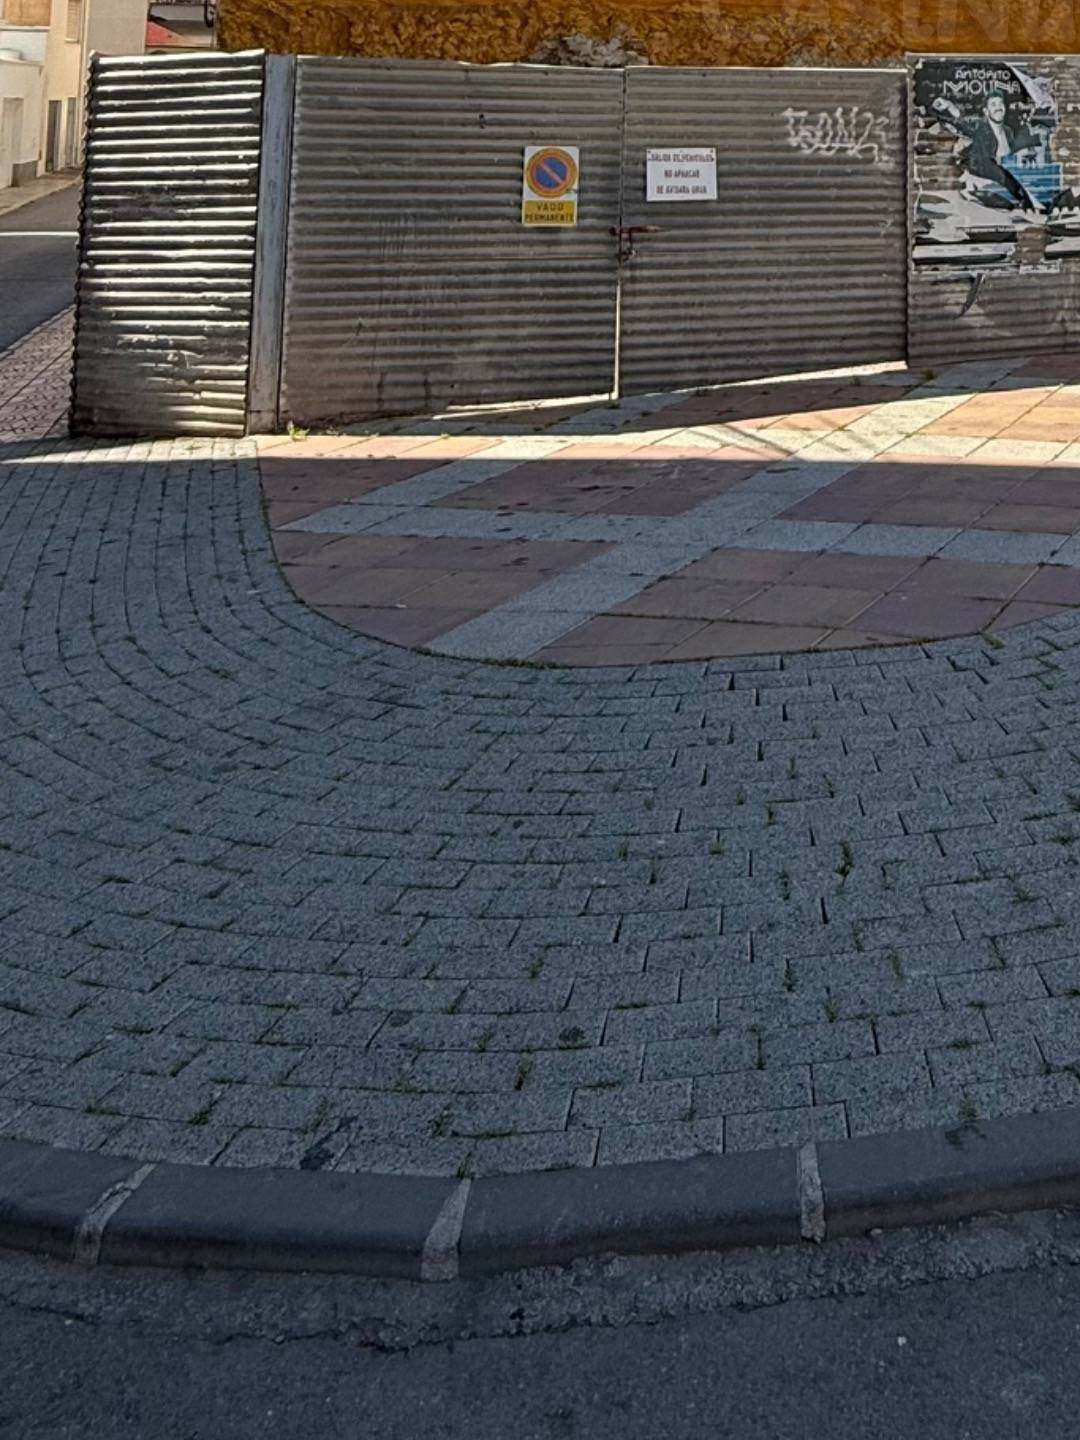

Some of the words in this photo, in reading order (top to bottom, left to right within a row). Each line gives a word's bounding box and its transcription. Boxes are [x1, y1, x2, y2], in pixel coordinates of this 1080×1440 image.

[674, 169, 700, 178] APARCAR
[536, 202, 565, 212] VADO
[525, 213, 574, 223] PERMANENTE
